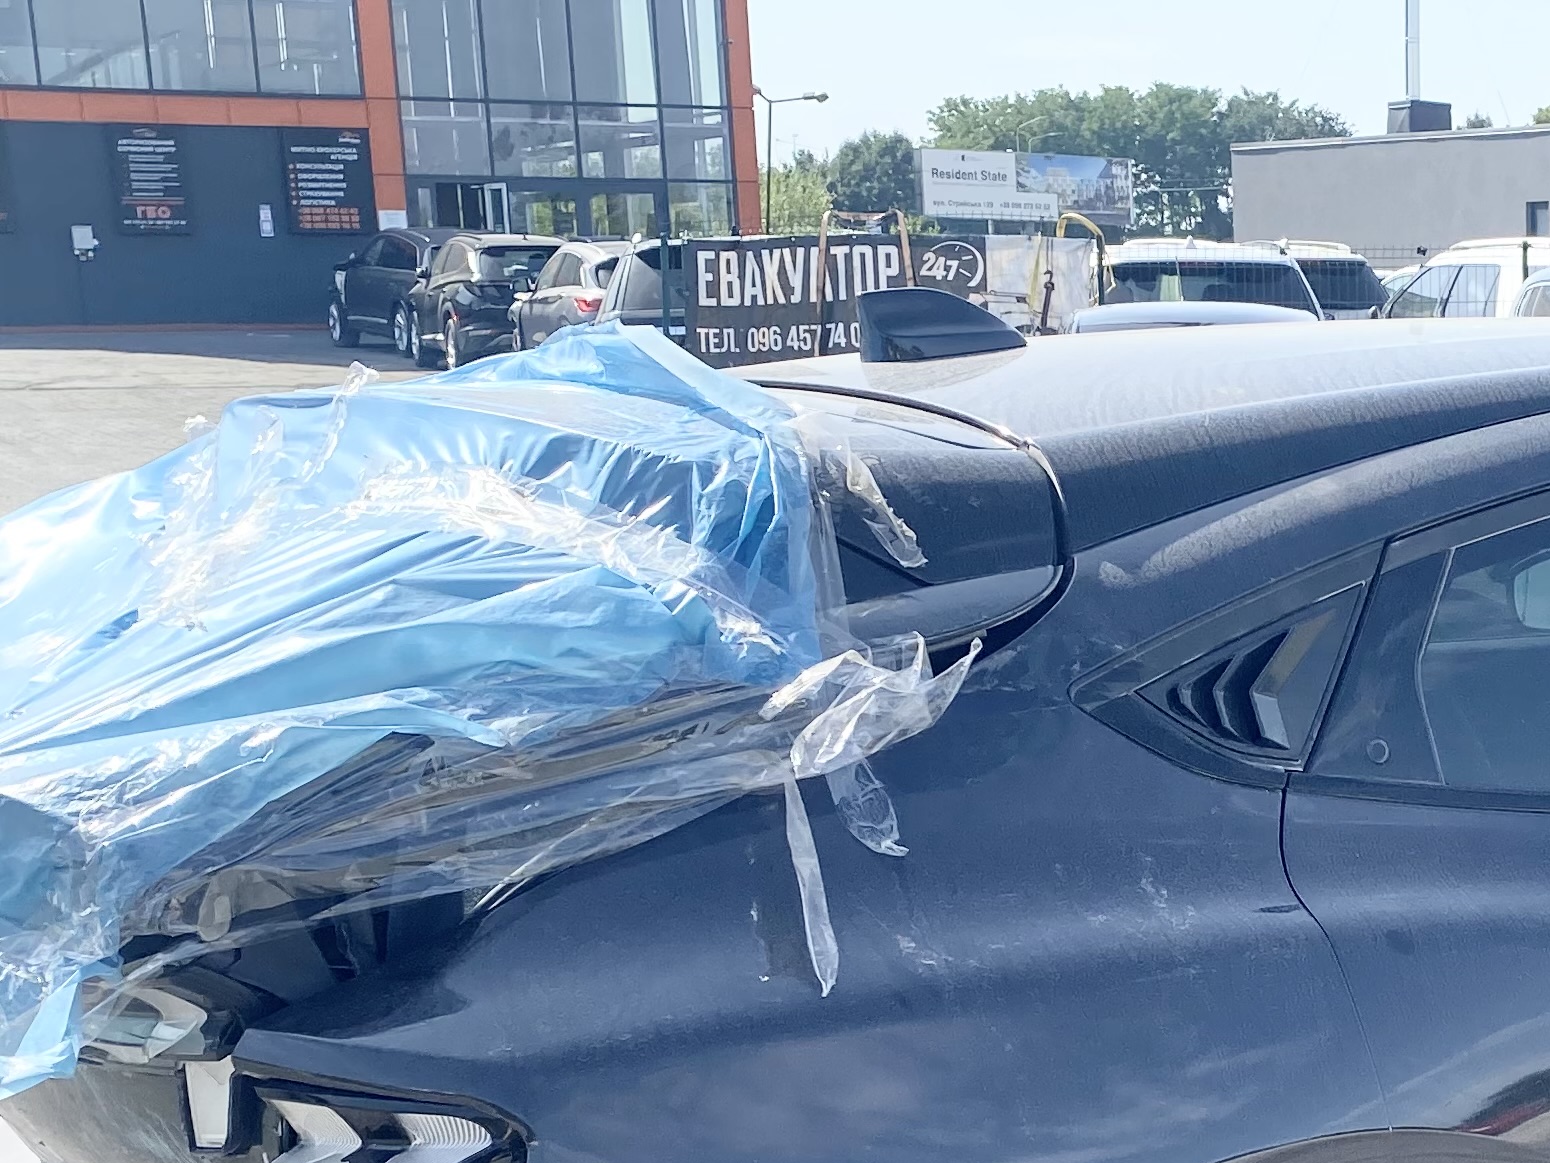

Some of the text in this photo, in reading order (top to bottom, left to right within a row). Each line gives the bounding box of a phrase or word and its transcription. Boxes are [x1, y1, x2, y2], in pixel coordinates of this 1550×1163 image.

[931, 167, 1008, 182] Resident State
[696, 244, 900, 307] ЕВАКУАТОР
[696, 327, 741, 353] ТЕЛ.
[747, 325, 783, 353] 096
[786, 324, 822, 352] 457
[825, 322, 847, 349] 74
